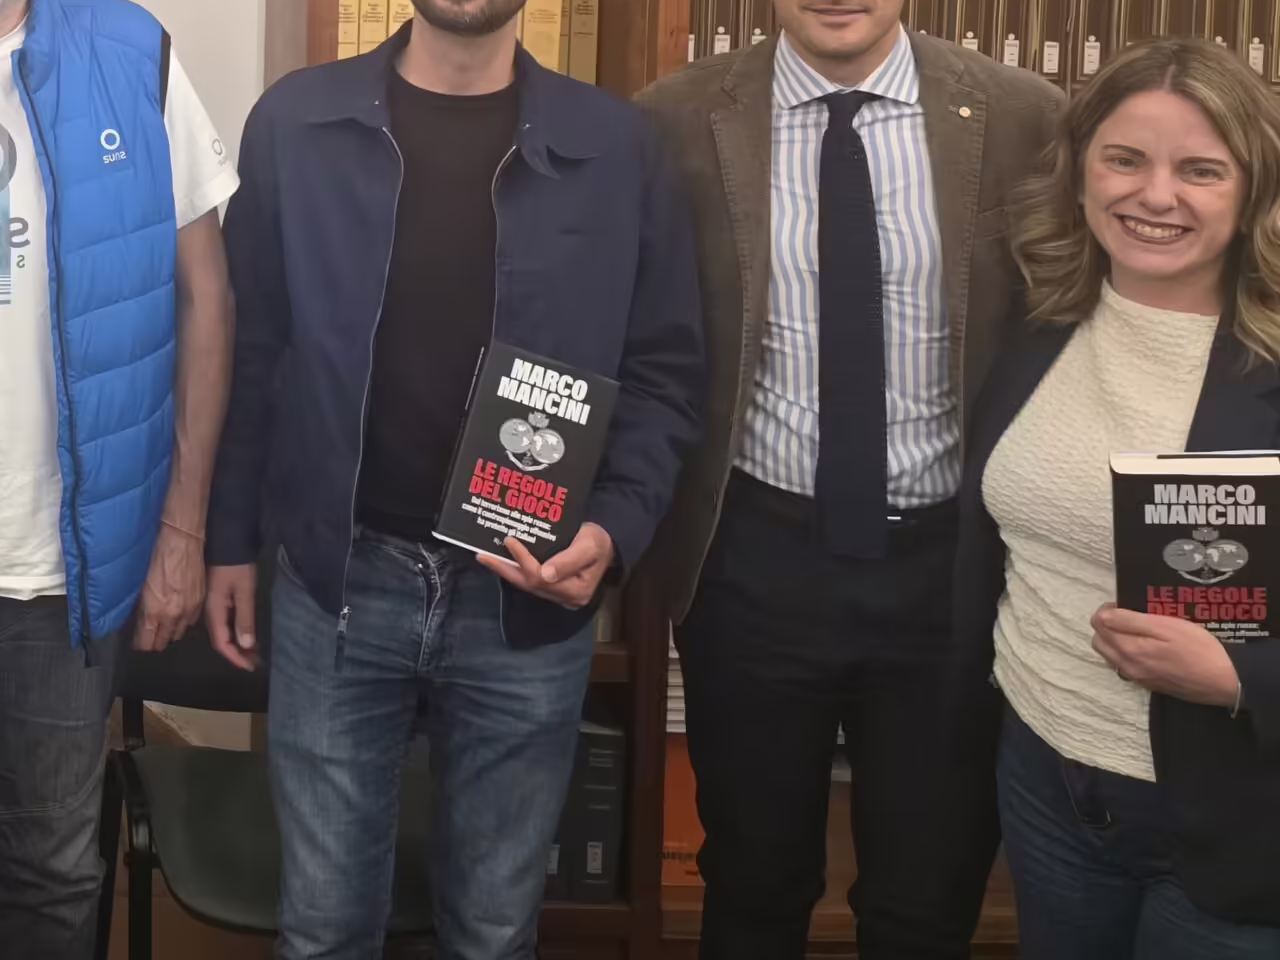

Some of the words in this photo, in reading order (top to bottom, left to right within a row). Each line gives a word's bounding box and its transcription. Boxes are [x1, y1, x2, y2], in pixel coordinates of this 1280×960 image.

[510, 358, 588, 401] MARCO
[497, 376, 591, 426] MANCINI
[473, 458, 497, 480] LE
[498, 466, 568, 505] REGOLE
[1153, 484, 1256, 505] MARCO
[469, 476, 501, 502] DEL
[505, 489, 562, 523] GIOCO
[1144, 504, 1266, 525] MANCINI
[1147, 585, 1174, 602] LE
[1178, 586, 1267, 603] REGOLE
[1147, 602, 1191, 618] DEL
[1194, 603, 1267, 620] GIOCO
